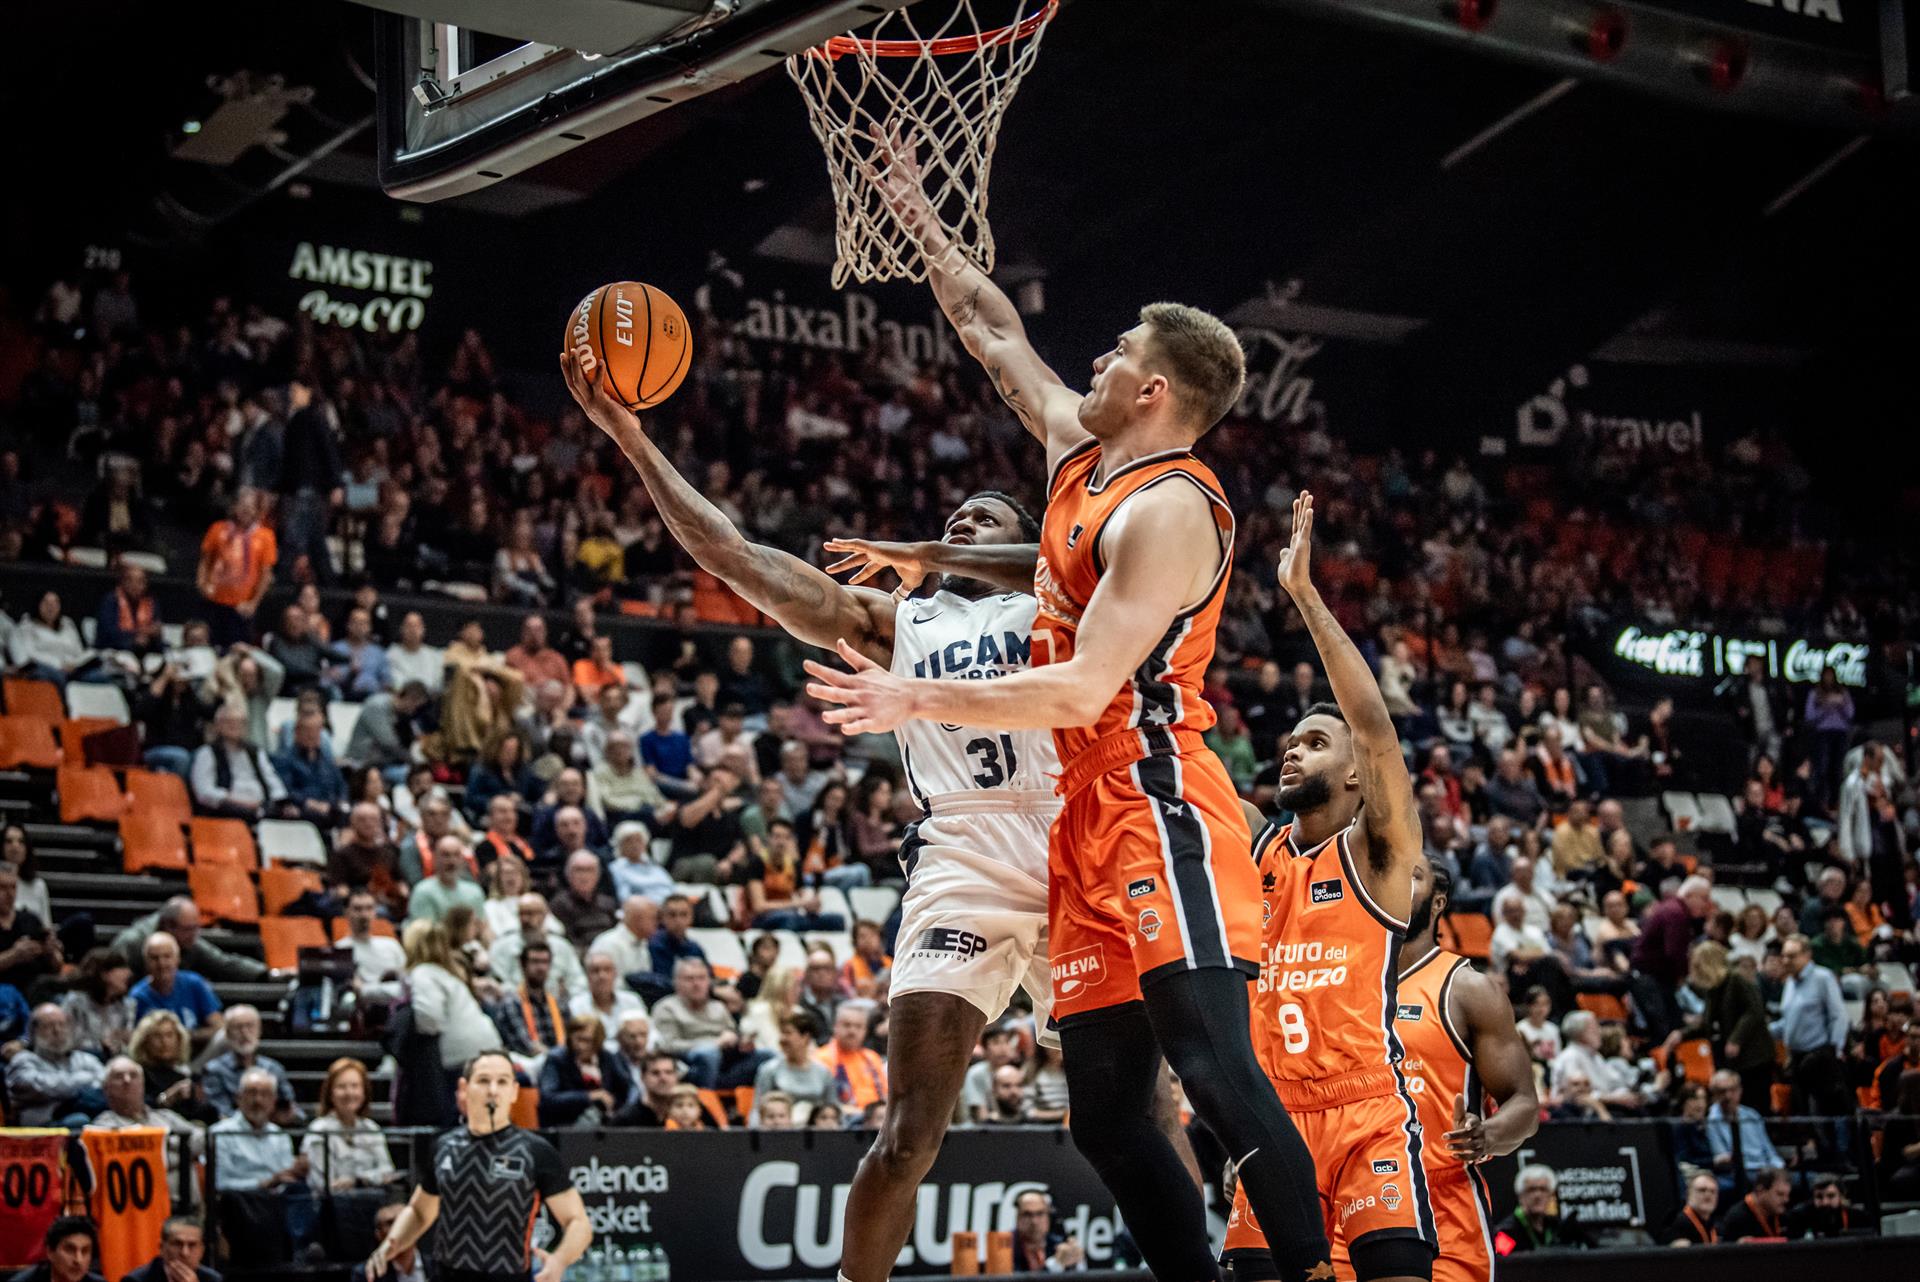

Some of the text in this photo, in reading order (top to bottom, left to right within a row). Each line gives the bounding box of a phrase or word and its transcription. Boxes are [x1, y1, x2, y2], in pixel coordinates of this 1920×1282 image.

[289, 242, 433, 298] AMSTEL
[616, 299, 633, 347] EVO
[914, 631, 1031, 679] UCAM
[966, 734, 1017, 789] 31
[1130, 885, 1150, 896] acb
[930, 928, 987, 957] ESP
[1325, 945, 1347, 960] del
[1278, 1003, 1309, 1054] 8
[3, 1162, 49, 1208] 00
[107, 1157, 153, 1214] 00
[1376, 1165, 1394, 1173] acb
